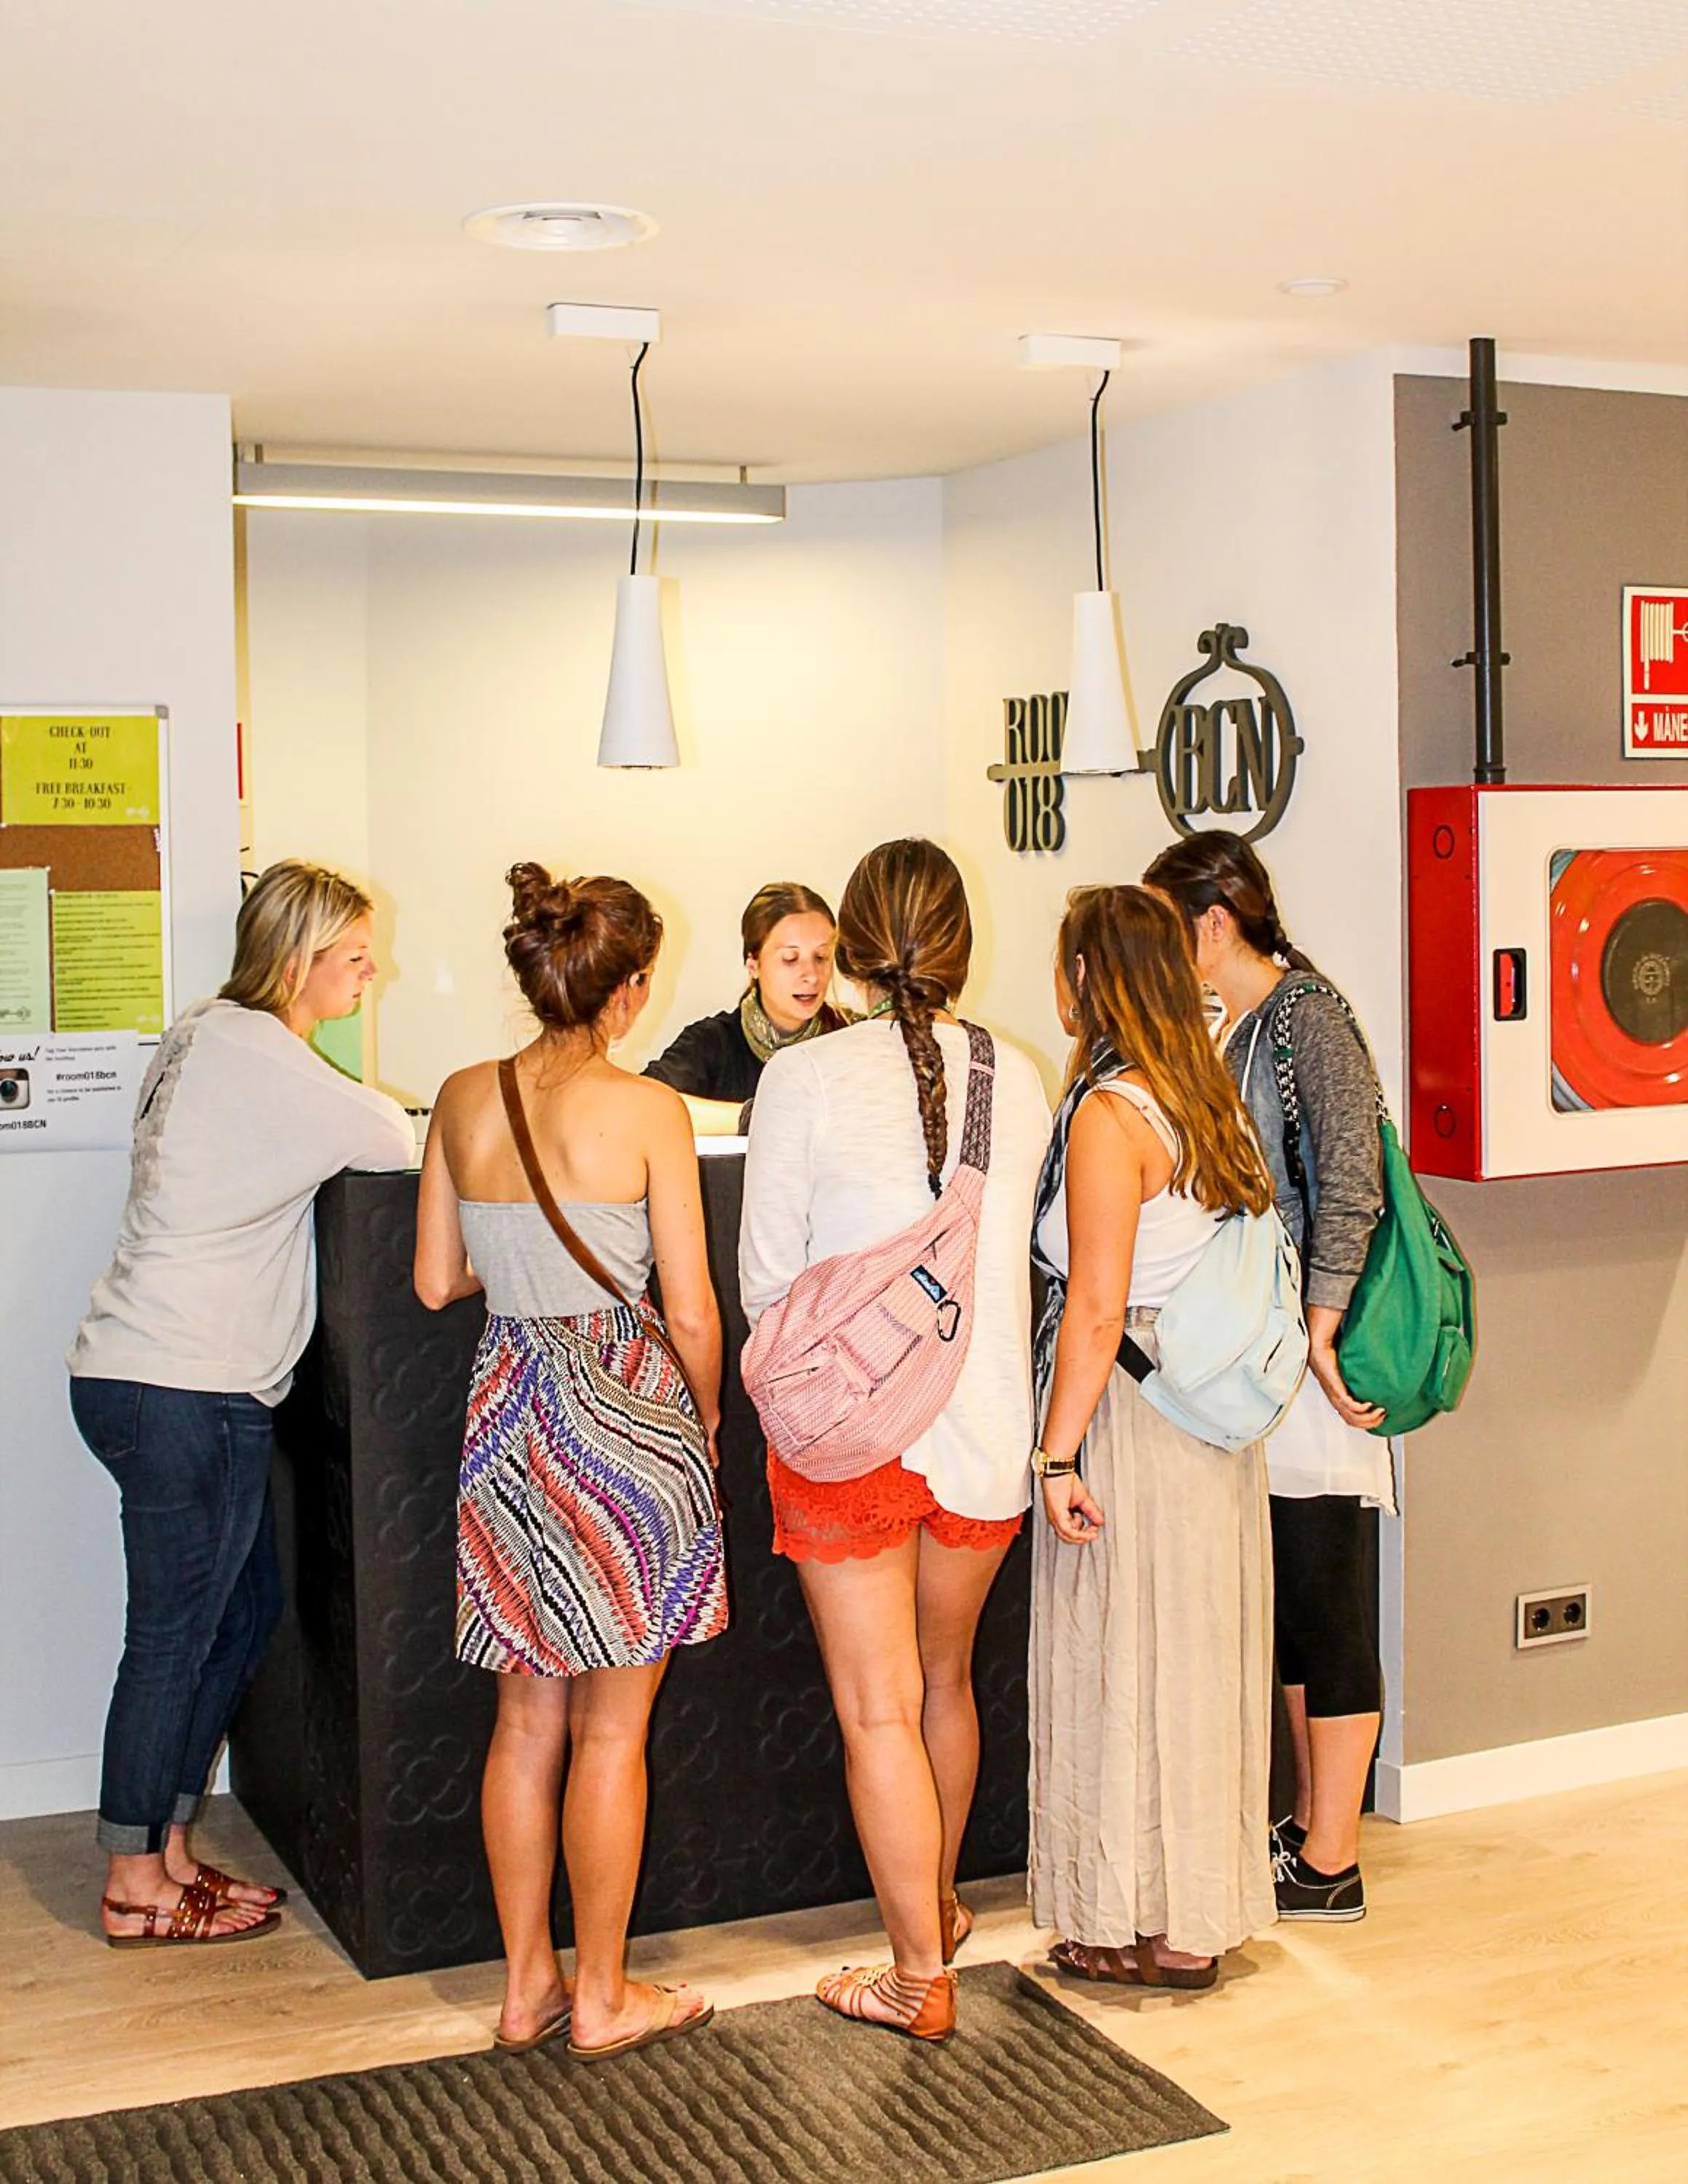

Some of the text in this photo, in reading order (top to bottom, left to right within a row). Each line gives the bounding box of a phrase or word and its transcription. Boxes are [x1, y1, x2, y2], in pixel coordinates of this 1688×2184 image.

[49, 726, 111, 738] CHECK OUT
[1003, 691, 1068, 764] ROO
[75, 741, 87, 753] AT
[1170, 699, 1274, 814] BCN
[36, 782, 126, 795] FREE BREAKFAST
[1003, 772, 1065, 851] 018
[56, 1071, 117, 1082] #room018bcn
